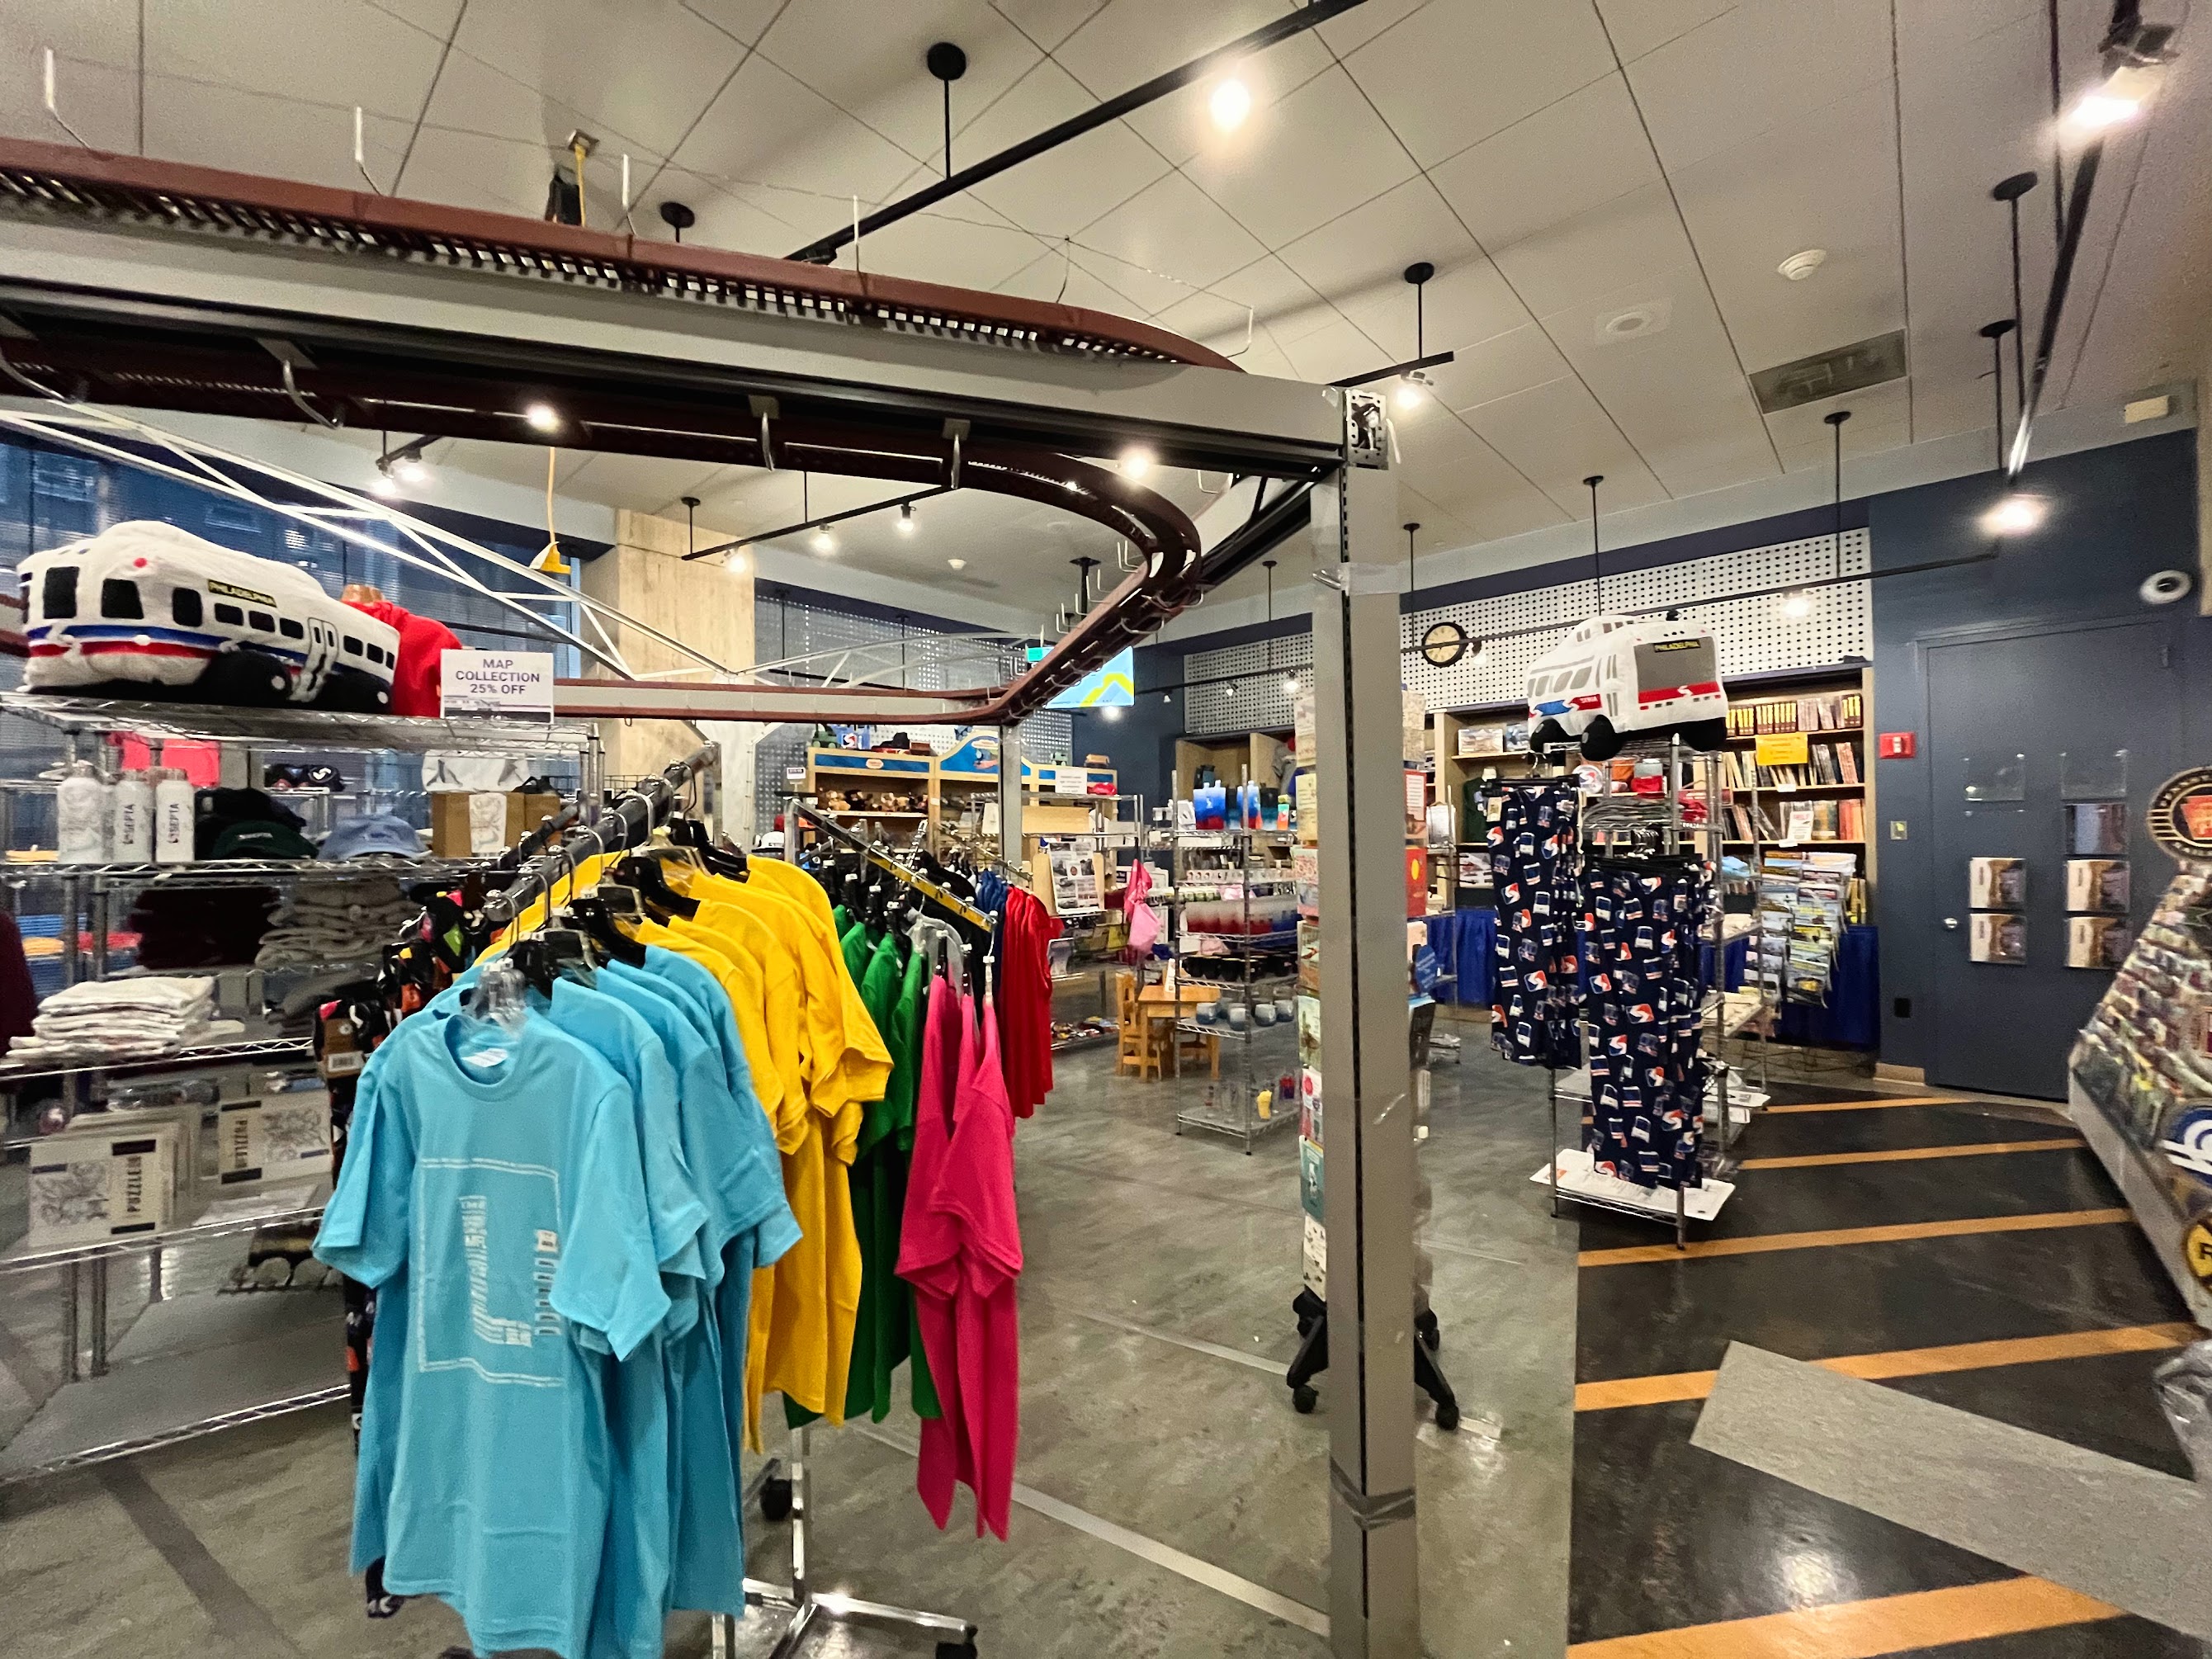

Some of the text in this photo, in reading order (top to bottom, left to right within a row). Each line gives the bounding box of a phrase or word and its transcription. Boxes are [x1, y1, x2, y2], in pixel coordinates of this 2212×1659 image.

[483, 659, 513, 669] MAP
[456, 671, 540, 683] COLLECTION
[470, 683, 526, 694] 25% OFF
